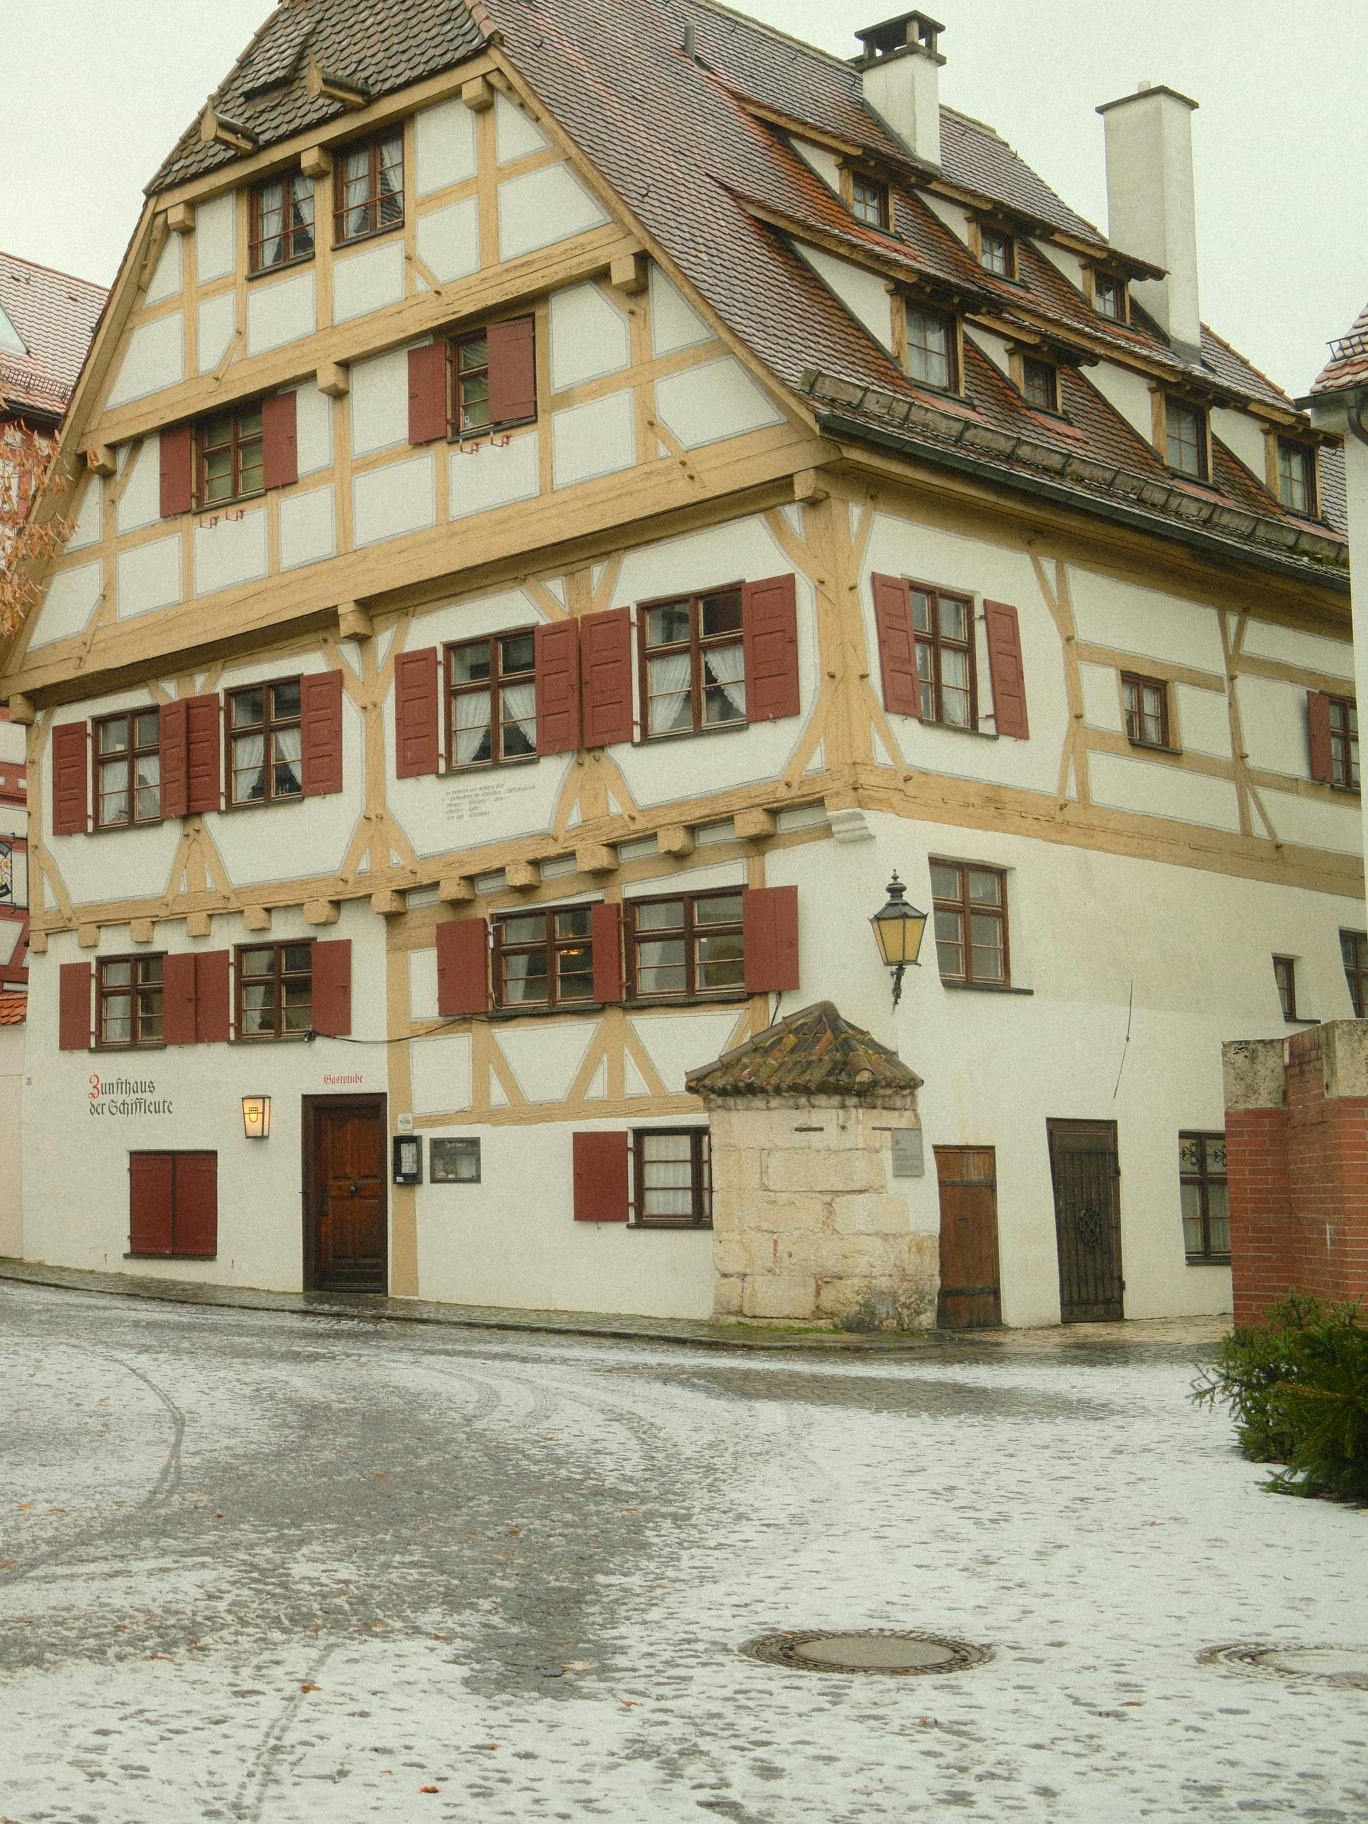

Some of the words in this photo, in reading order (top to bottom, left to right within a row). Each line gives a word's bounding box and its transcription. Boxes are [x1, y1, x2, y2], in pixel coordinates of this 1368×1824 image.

[88, 1072, 156, 1099] Zunfthaus
[89, 1100, 106, 1116] der
[108, 1097, 173, 1118] Schiffleute
